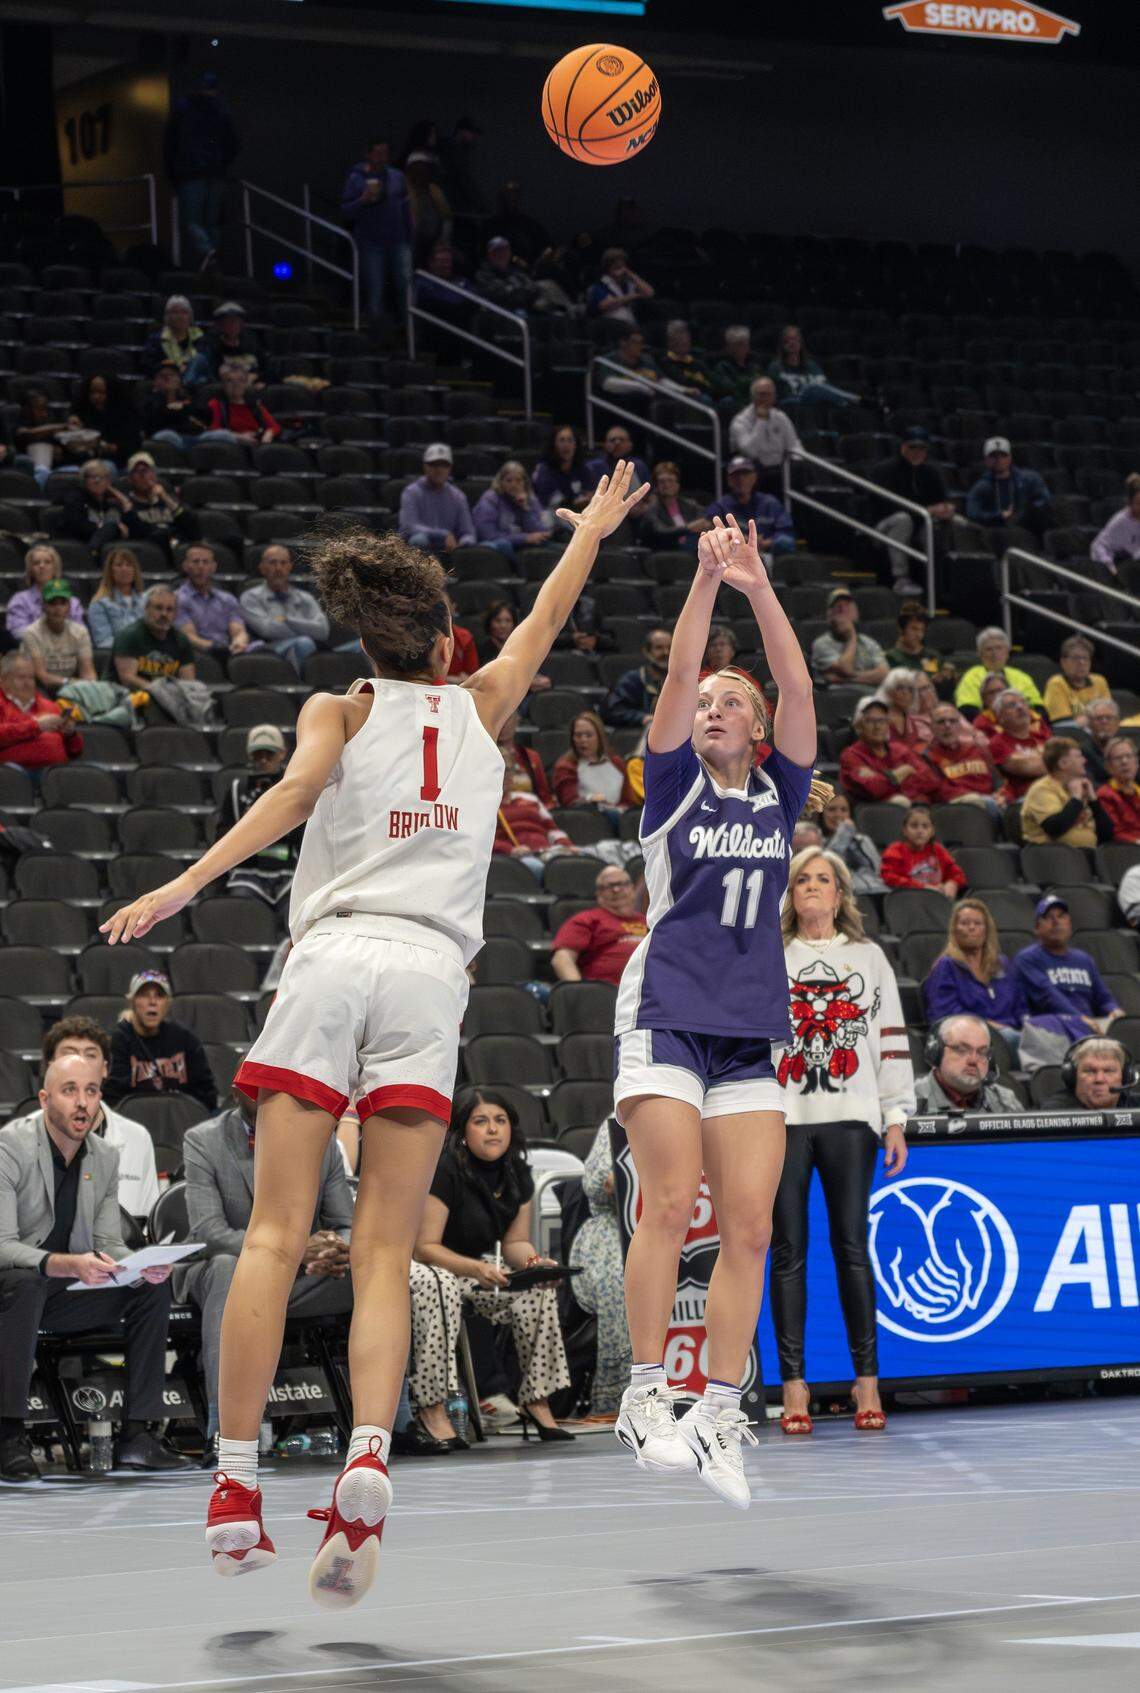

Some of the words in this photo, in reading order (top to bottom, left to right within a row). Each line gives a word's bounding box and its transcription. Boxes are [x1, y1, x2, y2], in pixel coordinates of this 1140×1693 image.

[923, 3, 1037, 34] SERVPRO
[64, 104, 111, 166] 107
[420, 725, 442, 802] 1
[688, 821, 786, 860] Wildcats
[720, 867, 764, 929] 11
